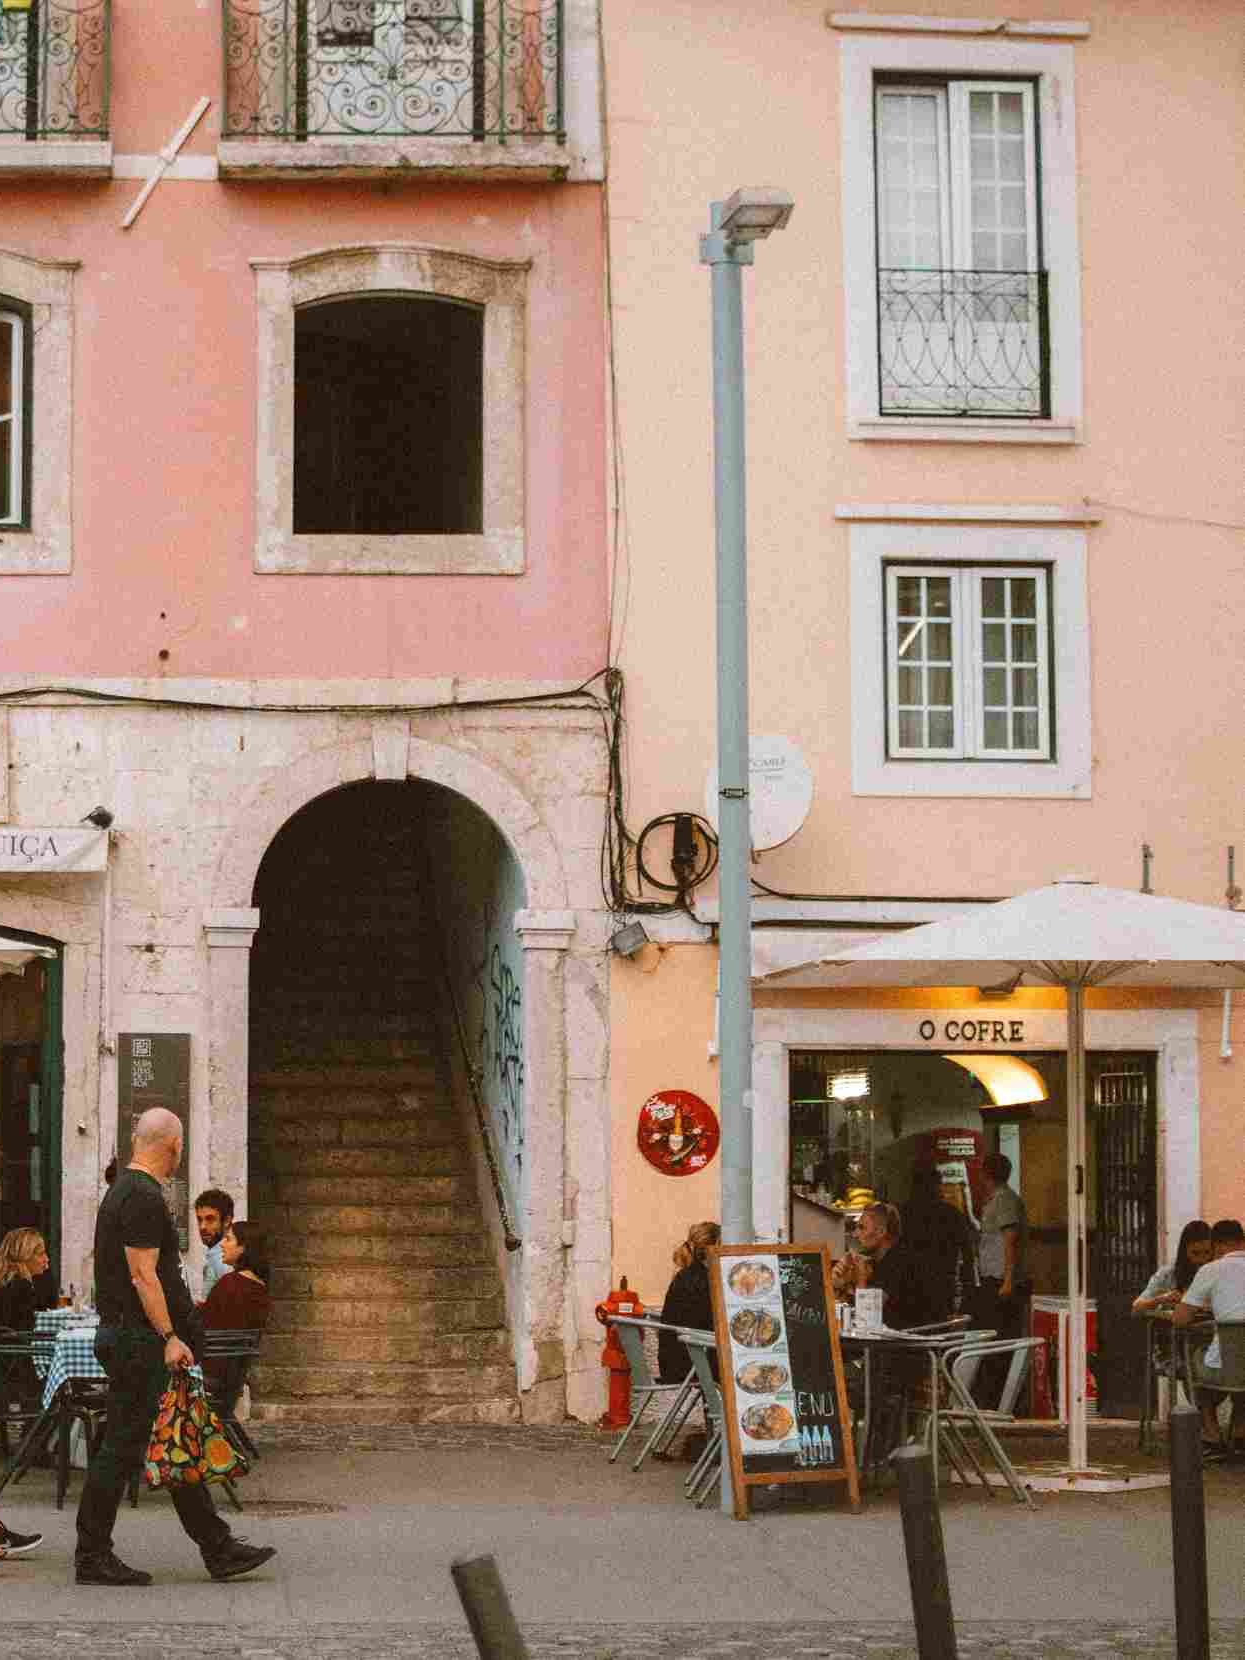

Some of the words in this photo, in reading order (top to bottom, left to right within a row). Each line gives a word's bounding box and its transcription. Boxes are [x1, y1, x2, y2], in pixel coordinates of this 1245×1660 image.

[919, 1020, 935, 1041] O
[944, 1020, 1024, 1042] COFRE
[795, 1391, 836, 1417] ENU
